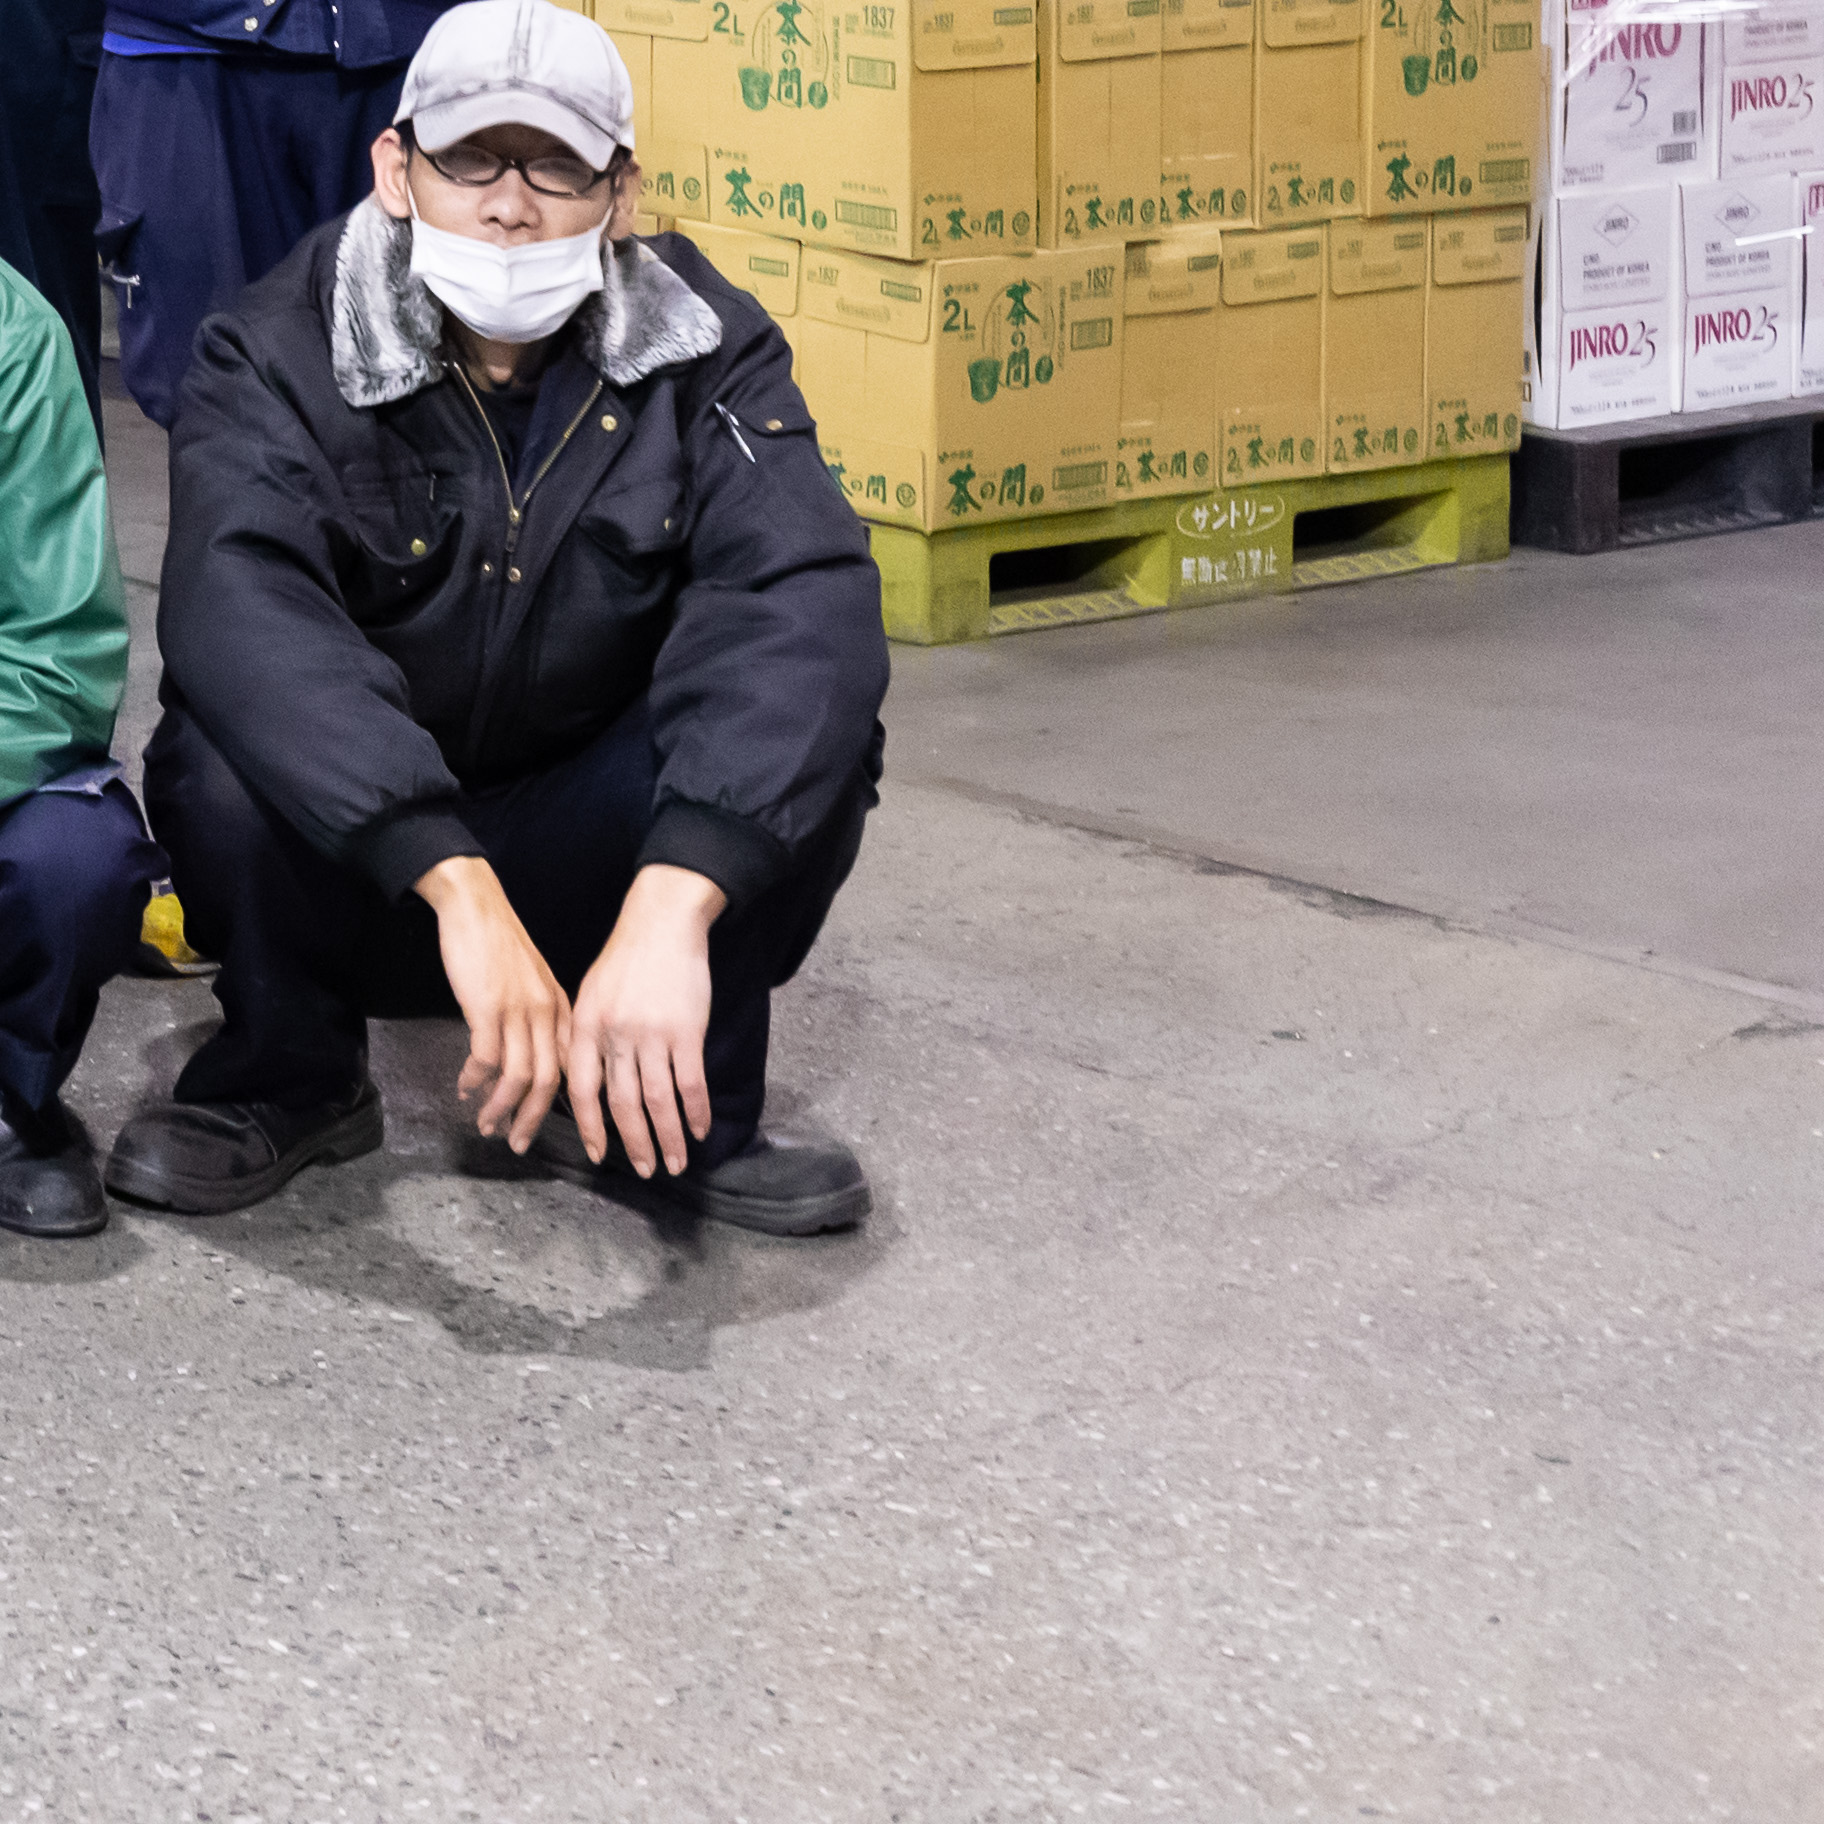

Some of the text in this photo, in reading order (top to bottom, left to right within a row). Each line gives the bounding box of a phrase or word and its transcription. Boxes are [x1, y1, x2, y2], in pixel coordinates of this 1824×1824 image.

[713, 1, 745, 36] 2L
[863, 5, 895, 29] 1837
[1614, 66, 1650, 127] 25
[1731, 73, 1815, 122] JINRO 25
[1386, 152, 1455, 201] 茶の間
[725, 166, 806, 228] 茶の間
[1085, 196, 1134, 230] 茶の間
[1176, 186, 1224, 220] 茶の間
[946, 206, 1004, 239] 茶の間
[1087, 267, 1114, 290] 1837
[943, 299, 976, 332] 2L
[1694, 306, 1778, 358] JINRO 25
[1006, 279, 1040, 390] 茶の間
[1570, 320, 1658, 372] JINRO 25
[1138, 451, 1187, 481] 茶の間
[1247, 438, 1294, 468] 茶の間
[948, 462, 1026, 516] 茶の間
[1192, 499, 1275, 531] サントリー
